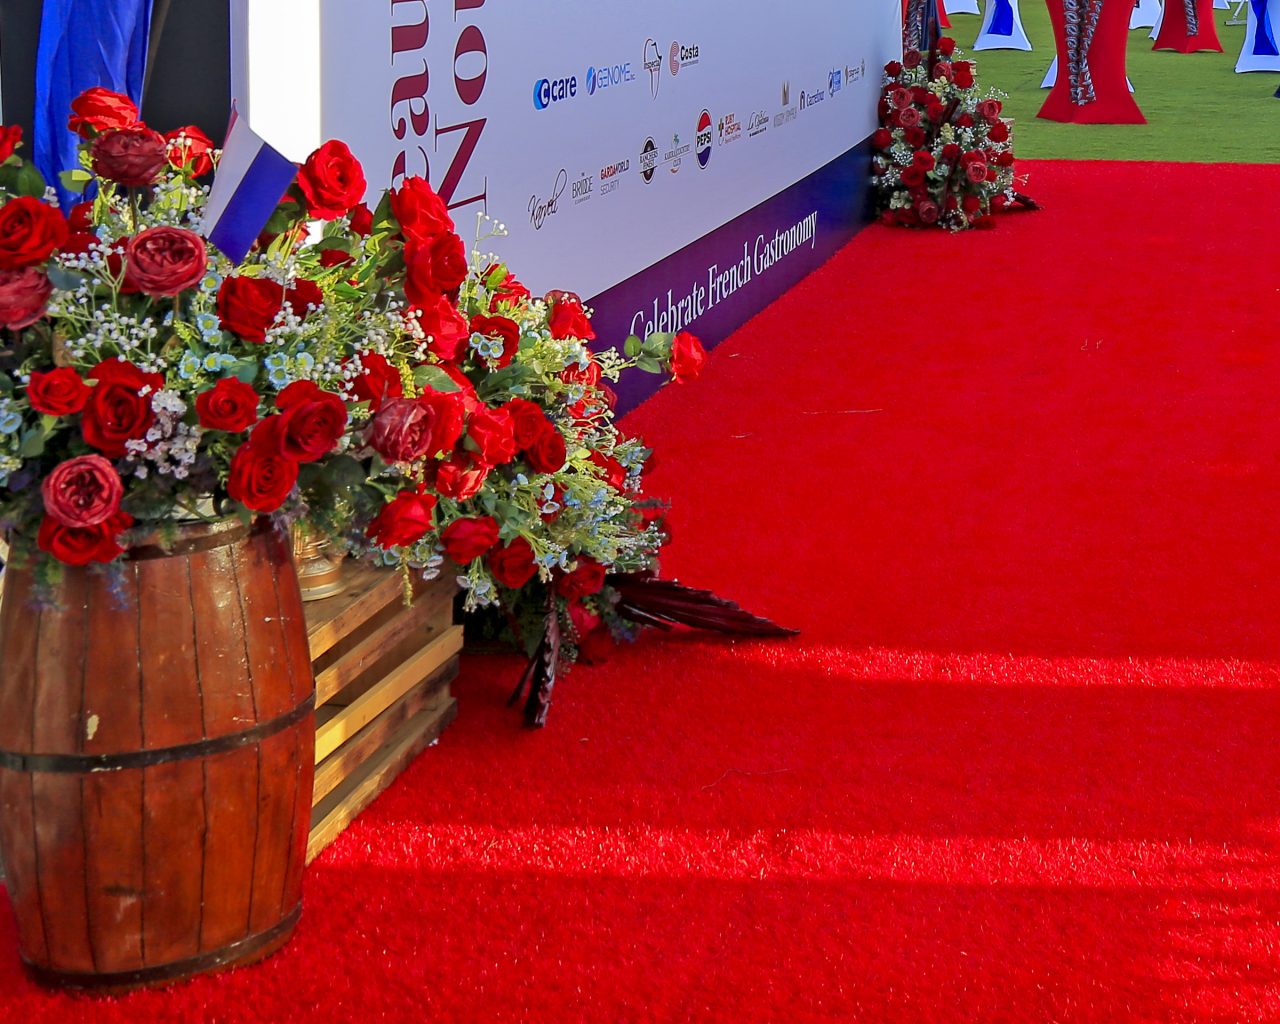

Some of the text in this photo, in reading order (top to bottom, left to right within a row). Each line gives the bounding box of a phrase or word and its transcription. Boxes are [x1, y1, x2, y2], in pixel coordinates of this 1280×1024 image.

[680, 44, 699, 61] Costa
[697, 131, 711, 147] PEPSI
[630, 210, 818, 341] Celebrate French Gastronomy
